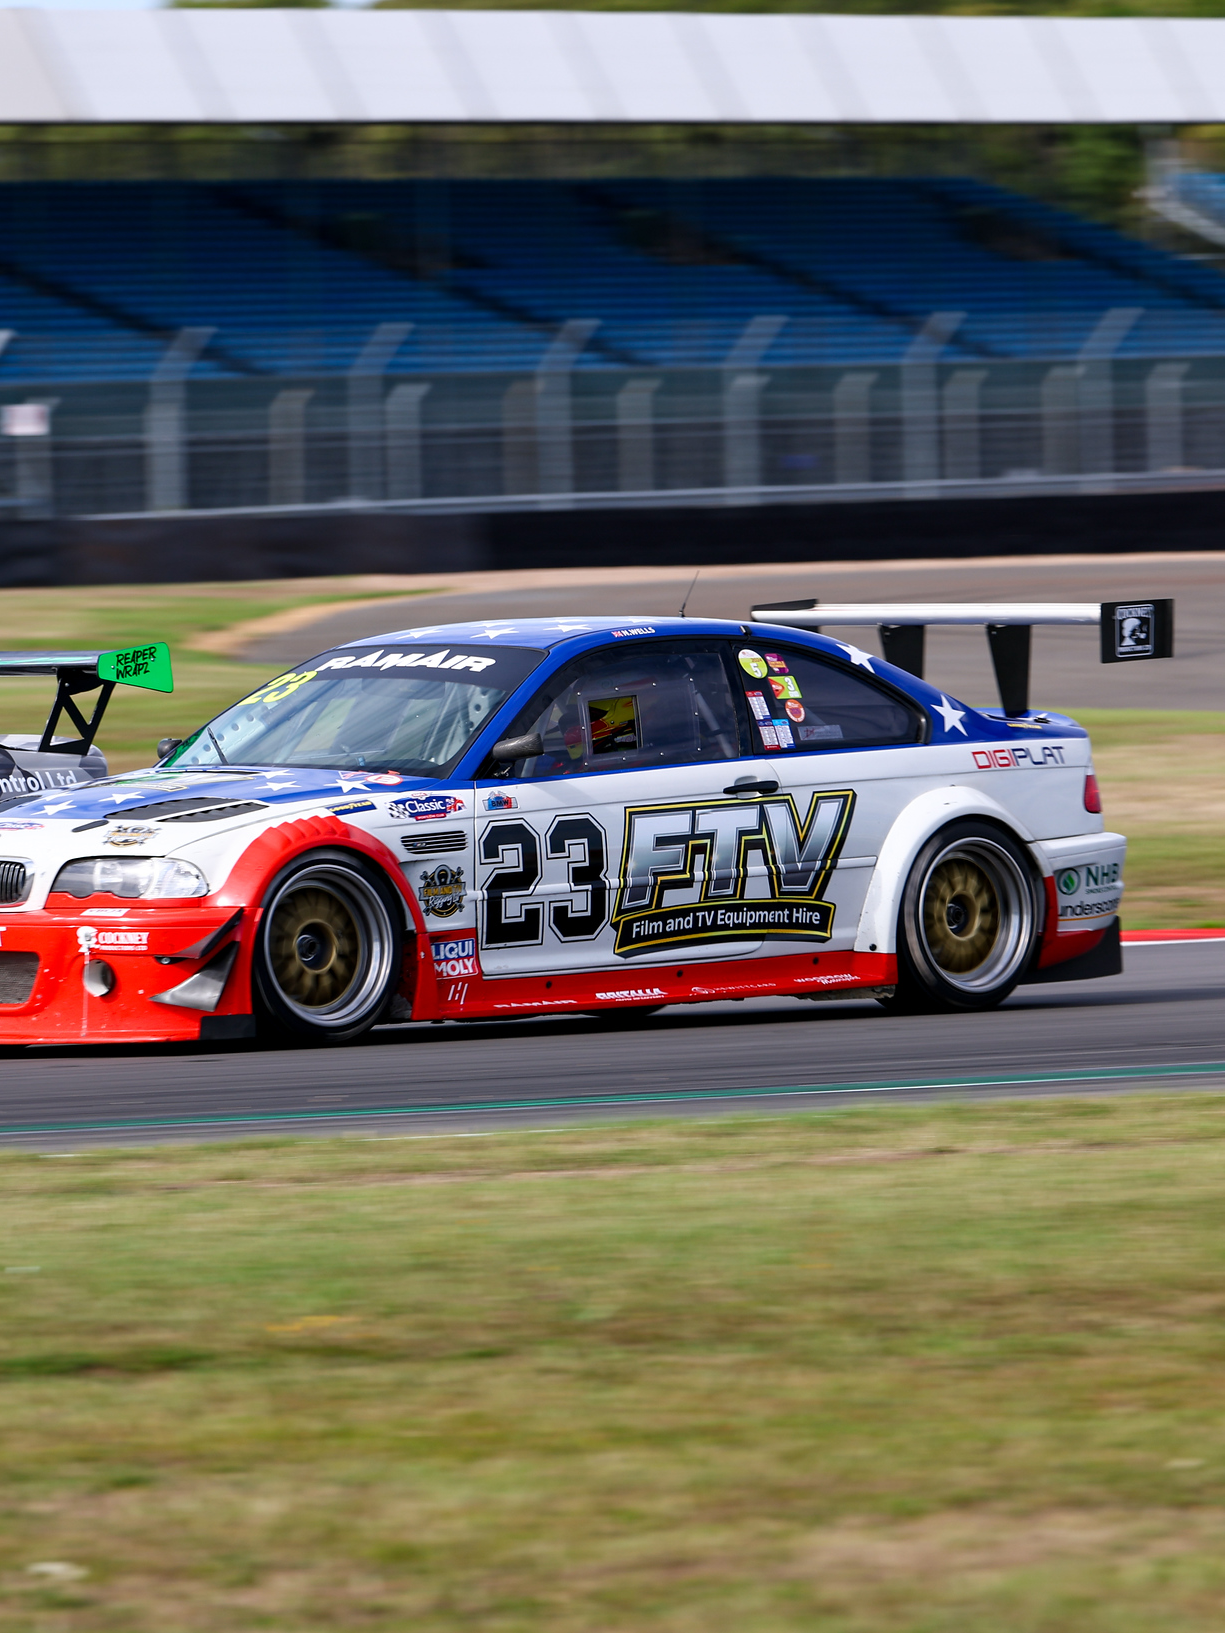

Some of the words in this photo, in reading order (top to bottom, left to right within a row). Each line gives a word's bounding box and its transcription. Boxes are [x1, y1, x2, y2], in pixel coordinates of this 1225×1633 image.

[116, 646, 157, 666] REAPER
[316, 649, 497, 672] RAMAIR
[116, 662, 151, 680] WRAPZ
[236, 670, 318, 706] 23
[971, 746, 1065, 770] DIGIPLAT
[405, 798, 446, 814] Classic
[491, 800, 510, 808] BMW
[617, 794, 850, 913] FTV
[478, 811, 610, 951] 23
[1085, 863, 1120, 887] NHB
[632, 919, 663, 939] Film
[665, 912, 694, 932] and
[696, 910, 715, 928] TV
[717, 907, 790, 929] Equipment
[792, 909, 821, 925] Hire
[431, 939, 473, 960] LIQUI
[433, 957, 475, 977] MOLY
